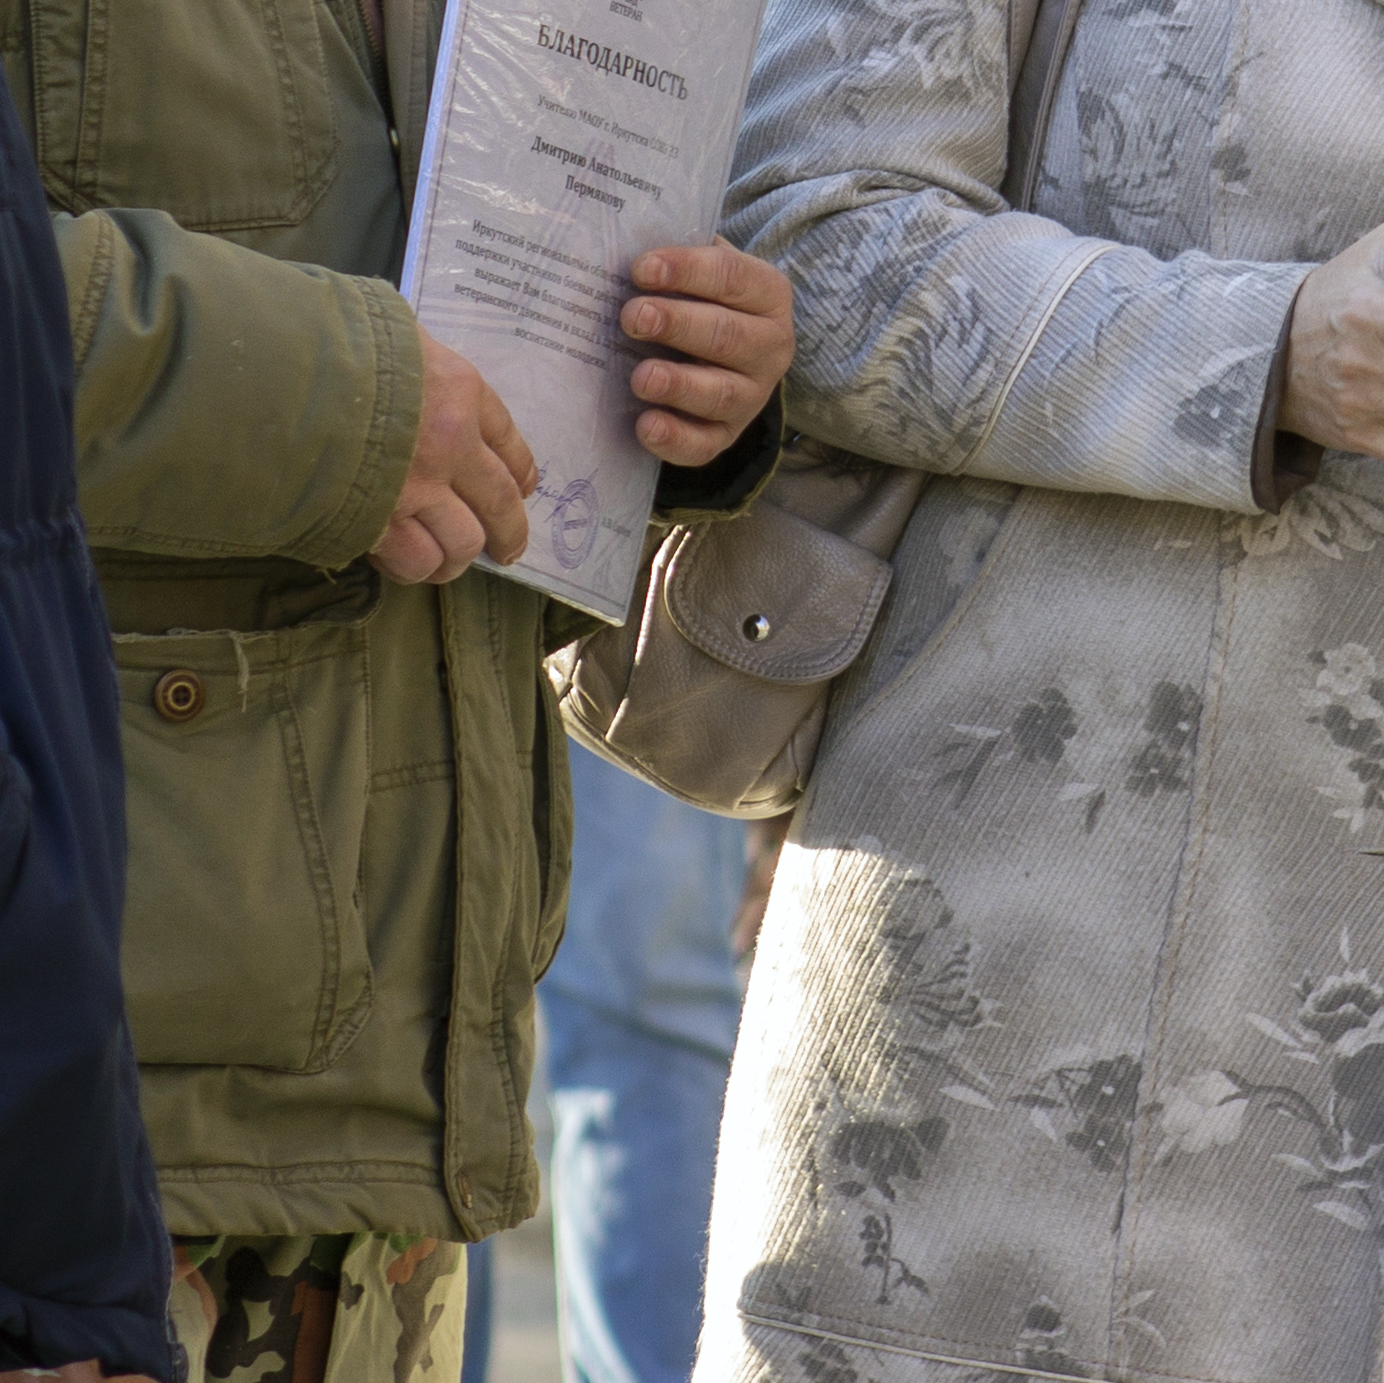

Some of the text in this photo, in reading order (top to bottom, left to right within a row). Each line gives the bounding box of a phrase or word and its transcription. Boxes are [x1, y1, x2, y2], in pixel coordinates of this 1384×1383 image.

[609, 0, 643, 23] ВЕТЕРАН
[537, 24, 688, 100] БЛАГОДАРНОСТЬ
[537, 94, 577, 120] Учителю
[579, 109, 604, 129] МАОУ
[531, 136, 664, 201] Дмитрию Анатольевичу
[565, 174, 626, 213] Пермякову
[472, 219, 525, 249] Иркутский
[455, 238, 510, 266] поддержки
[511, 258, 563, 285] участников
[453, 282, 518, 313] ветеранского
[474, 267, 521, 293] выражает
[523, 282, 541, 299] Вам
[541, 289, 602, 324] благодарность
